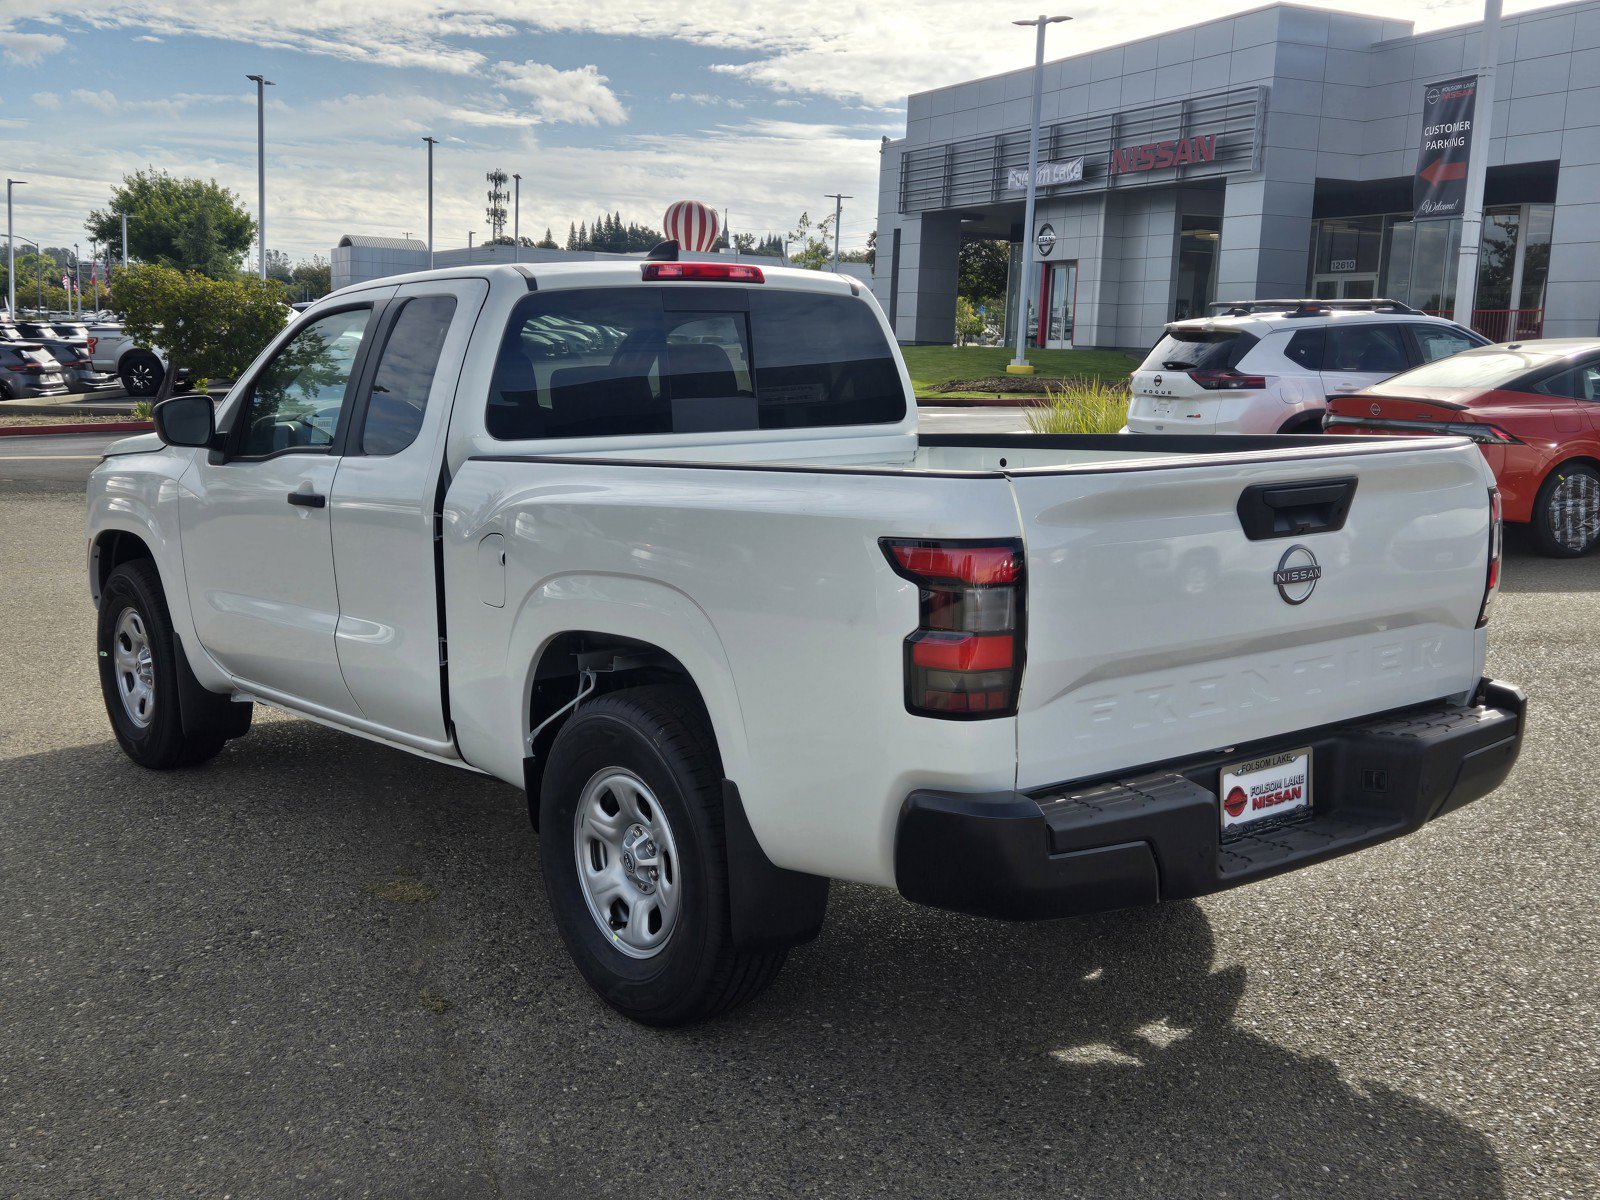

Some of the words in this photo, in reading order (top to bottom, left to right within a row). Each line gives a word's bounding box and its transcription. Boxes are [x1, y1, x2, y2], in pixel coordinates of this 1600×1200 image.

[1424, 120, 1471, 136] CUSTOMER
[1425, 137, 1464, 150] PARKING
[1111, 134, 1217, 174] NISSAN
[1421, 199, 1459, 214] Welcome!
[1332, 261, 1355, 270] 12610
[1276, 568, 1321, 583] NISSAN
[1241, 758, 1271, 773] FOLSOM
[1273, 753, 1291, 765] LAKE
[1250, 779, 1282, 797] FOLSOM
[1283, 774, 1304, 787] LAKE
[1252, 786, 1301, 810] NISSAN
